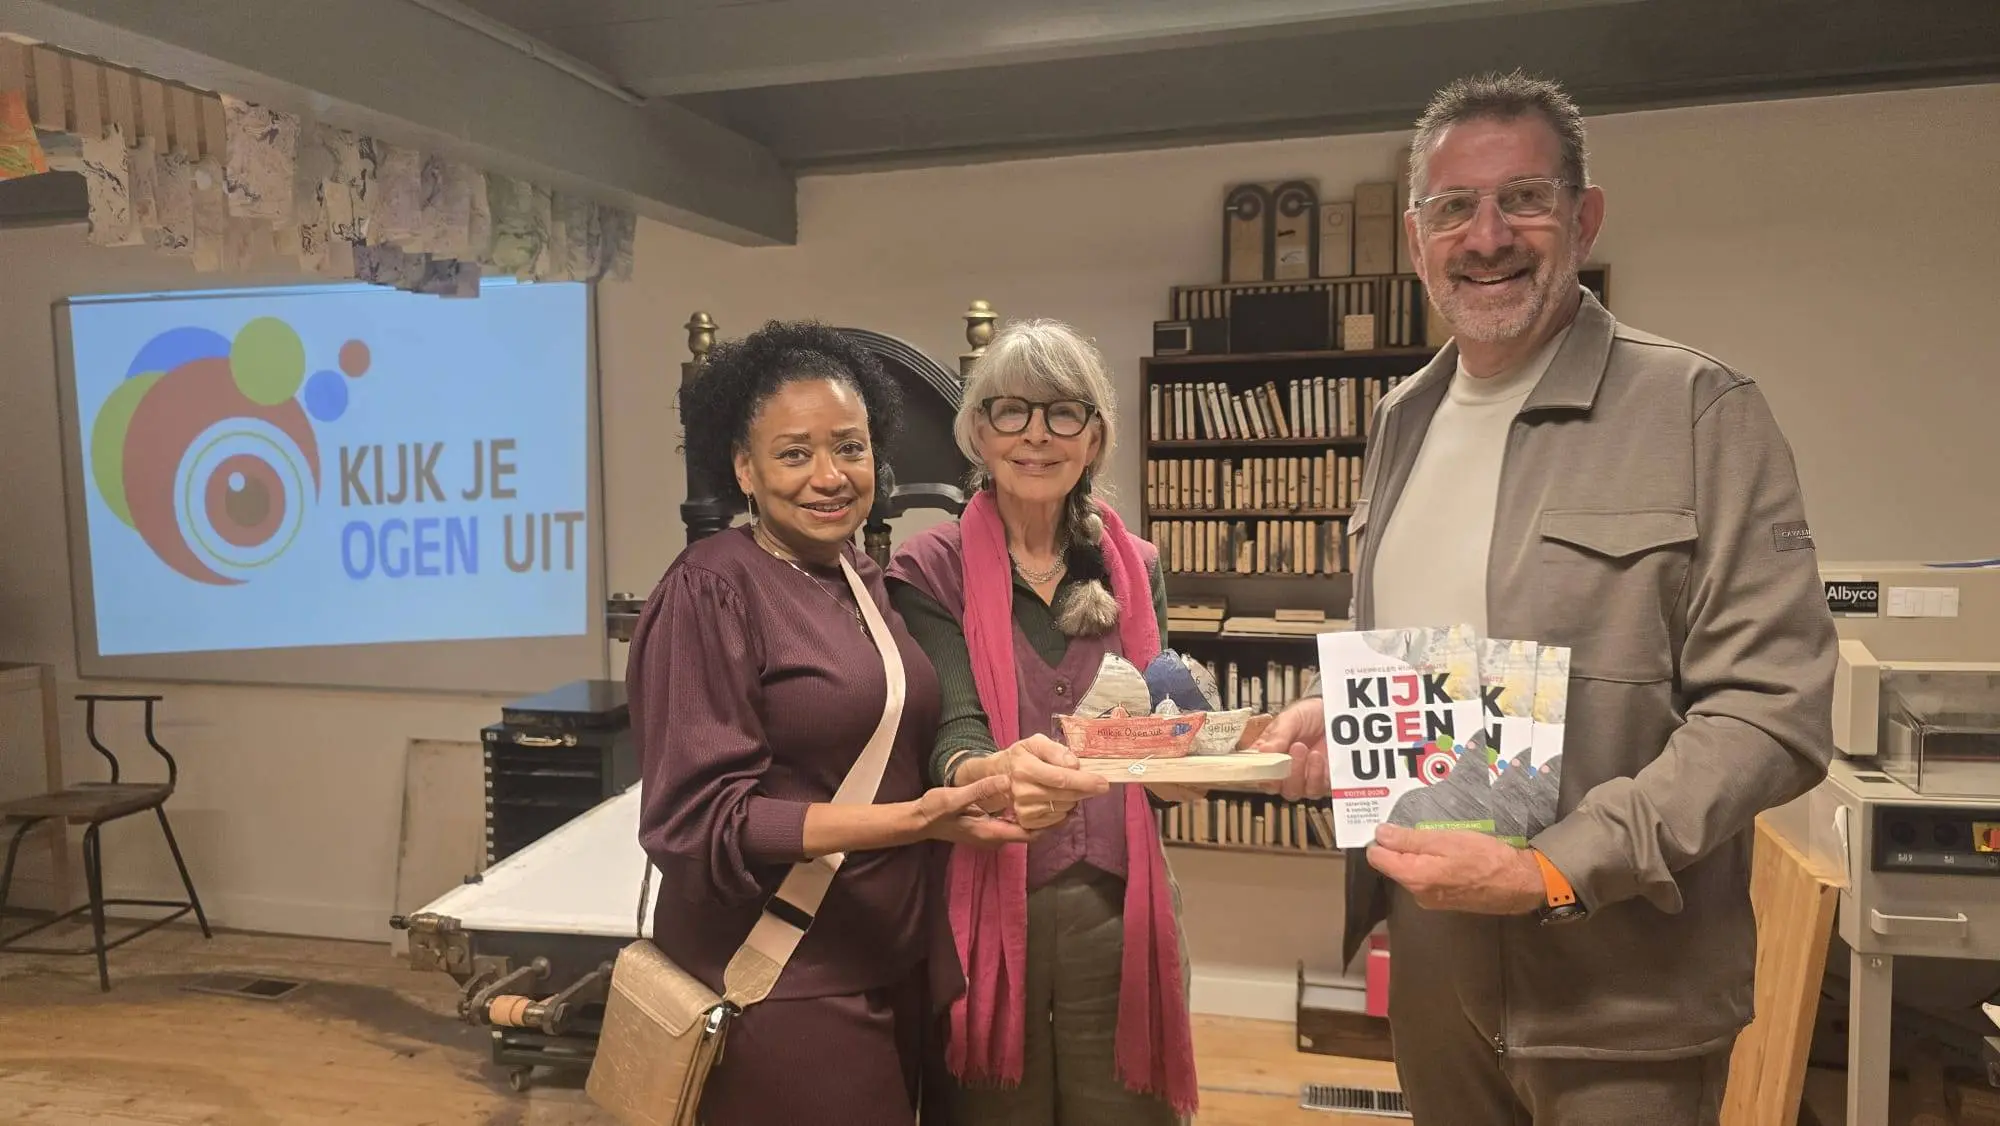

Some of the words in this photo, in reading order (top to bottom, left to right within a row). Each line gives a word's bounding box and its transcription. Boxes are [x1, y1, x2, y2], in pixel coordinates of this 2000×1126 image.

[339, 441, 445, 506] KIJK
[461, 438, 517, 501] JE
[340, 516, 480, 580] OGEN
[503, 511, 585, 573] UIT
[1826, 585, 1877, 604] Albyco
[1346, 672, 1454, 709] KIJK
[1331, 709, 1455, 745] OGEN
[1351, 747, 1425, 780] UIT
